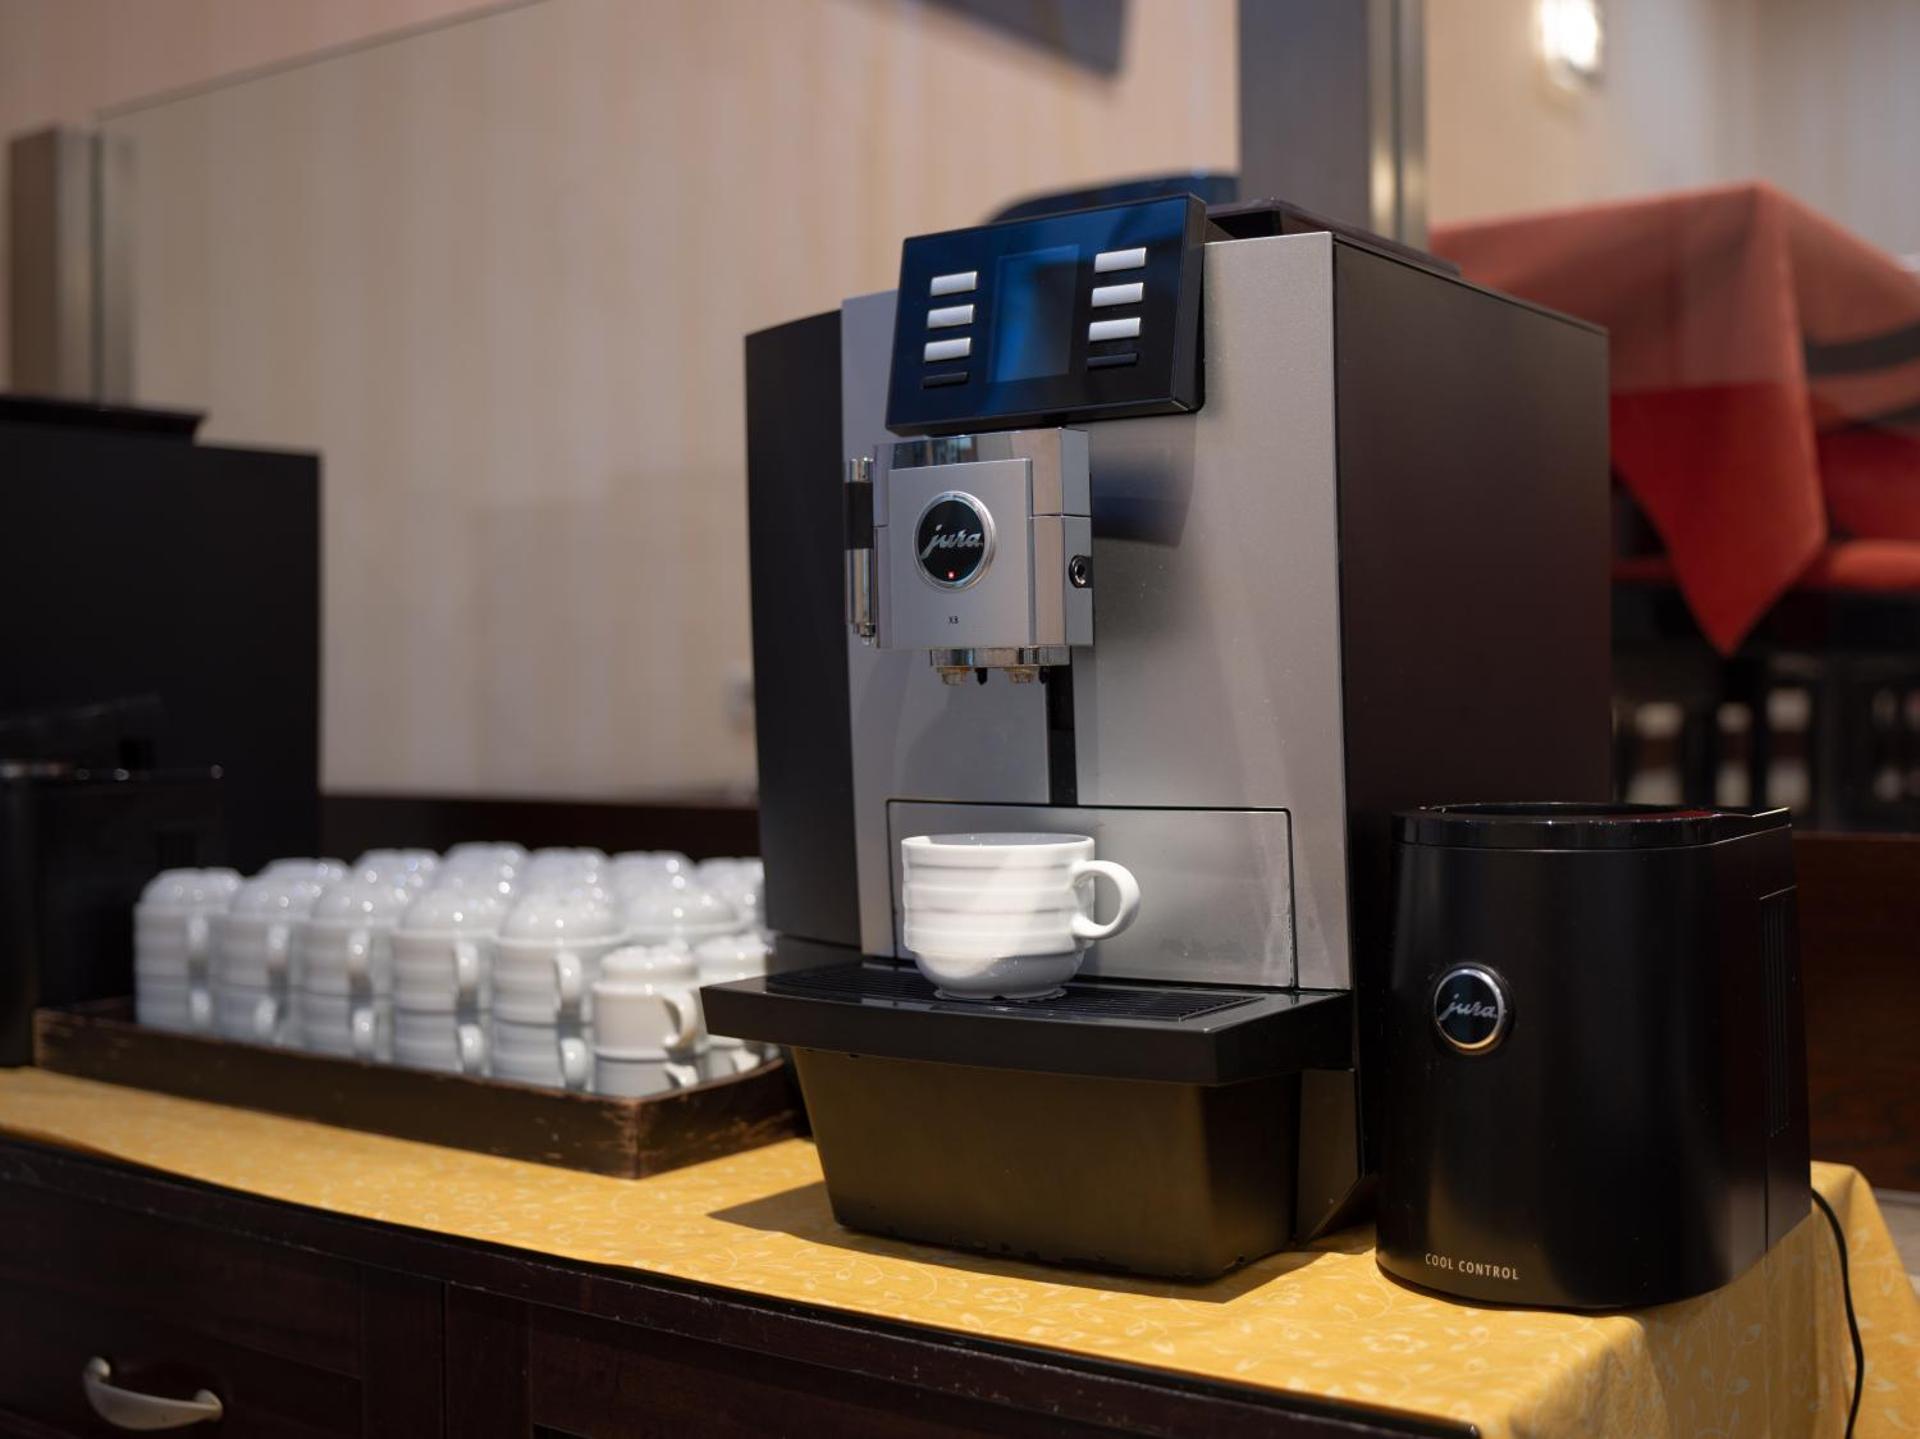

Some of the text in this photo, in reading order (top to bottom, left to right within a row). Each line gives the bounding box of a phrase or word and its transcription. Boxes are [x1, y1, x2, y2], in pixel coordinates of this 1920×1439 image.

[920, 523, 984, 560] jura
[1438, 993, 1500, 1021] jura
[1425, 1252, 1520, 1280] COOL CONTROL
